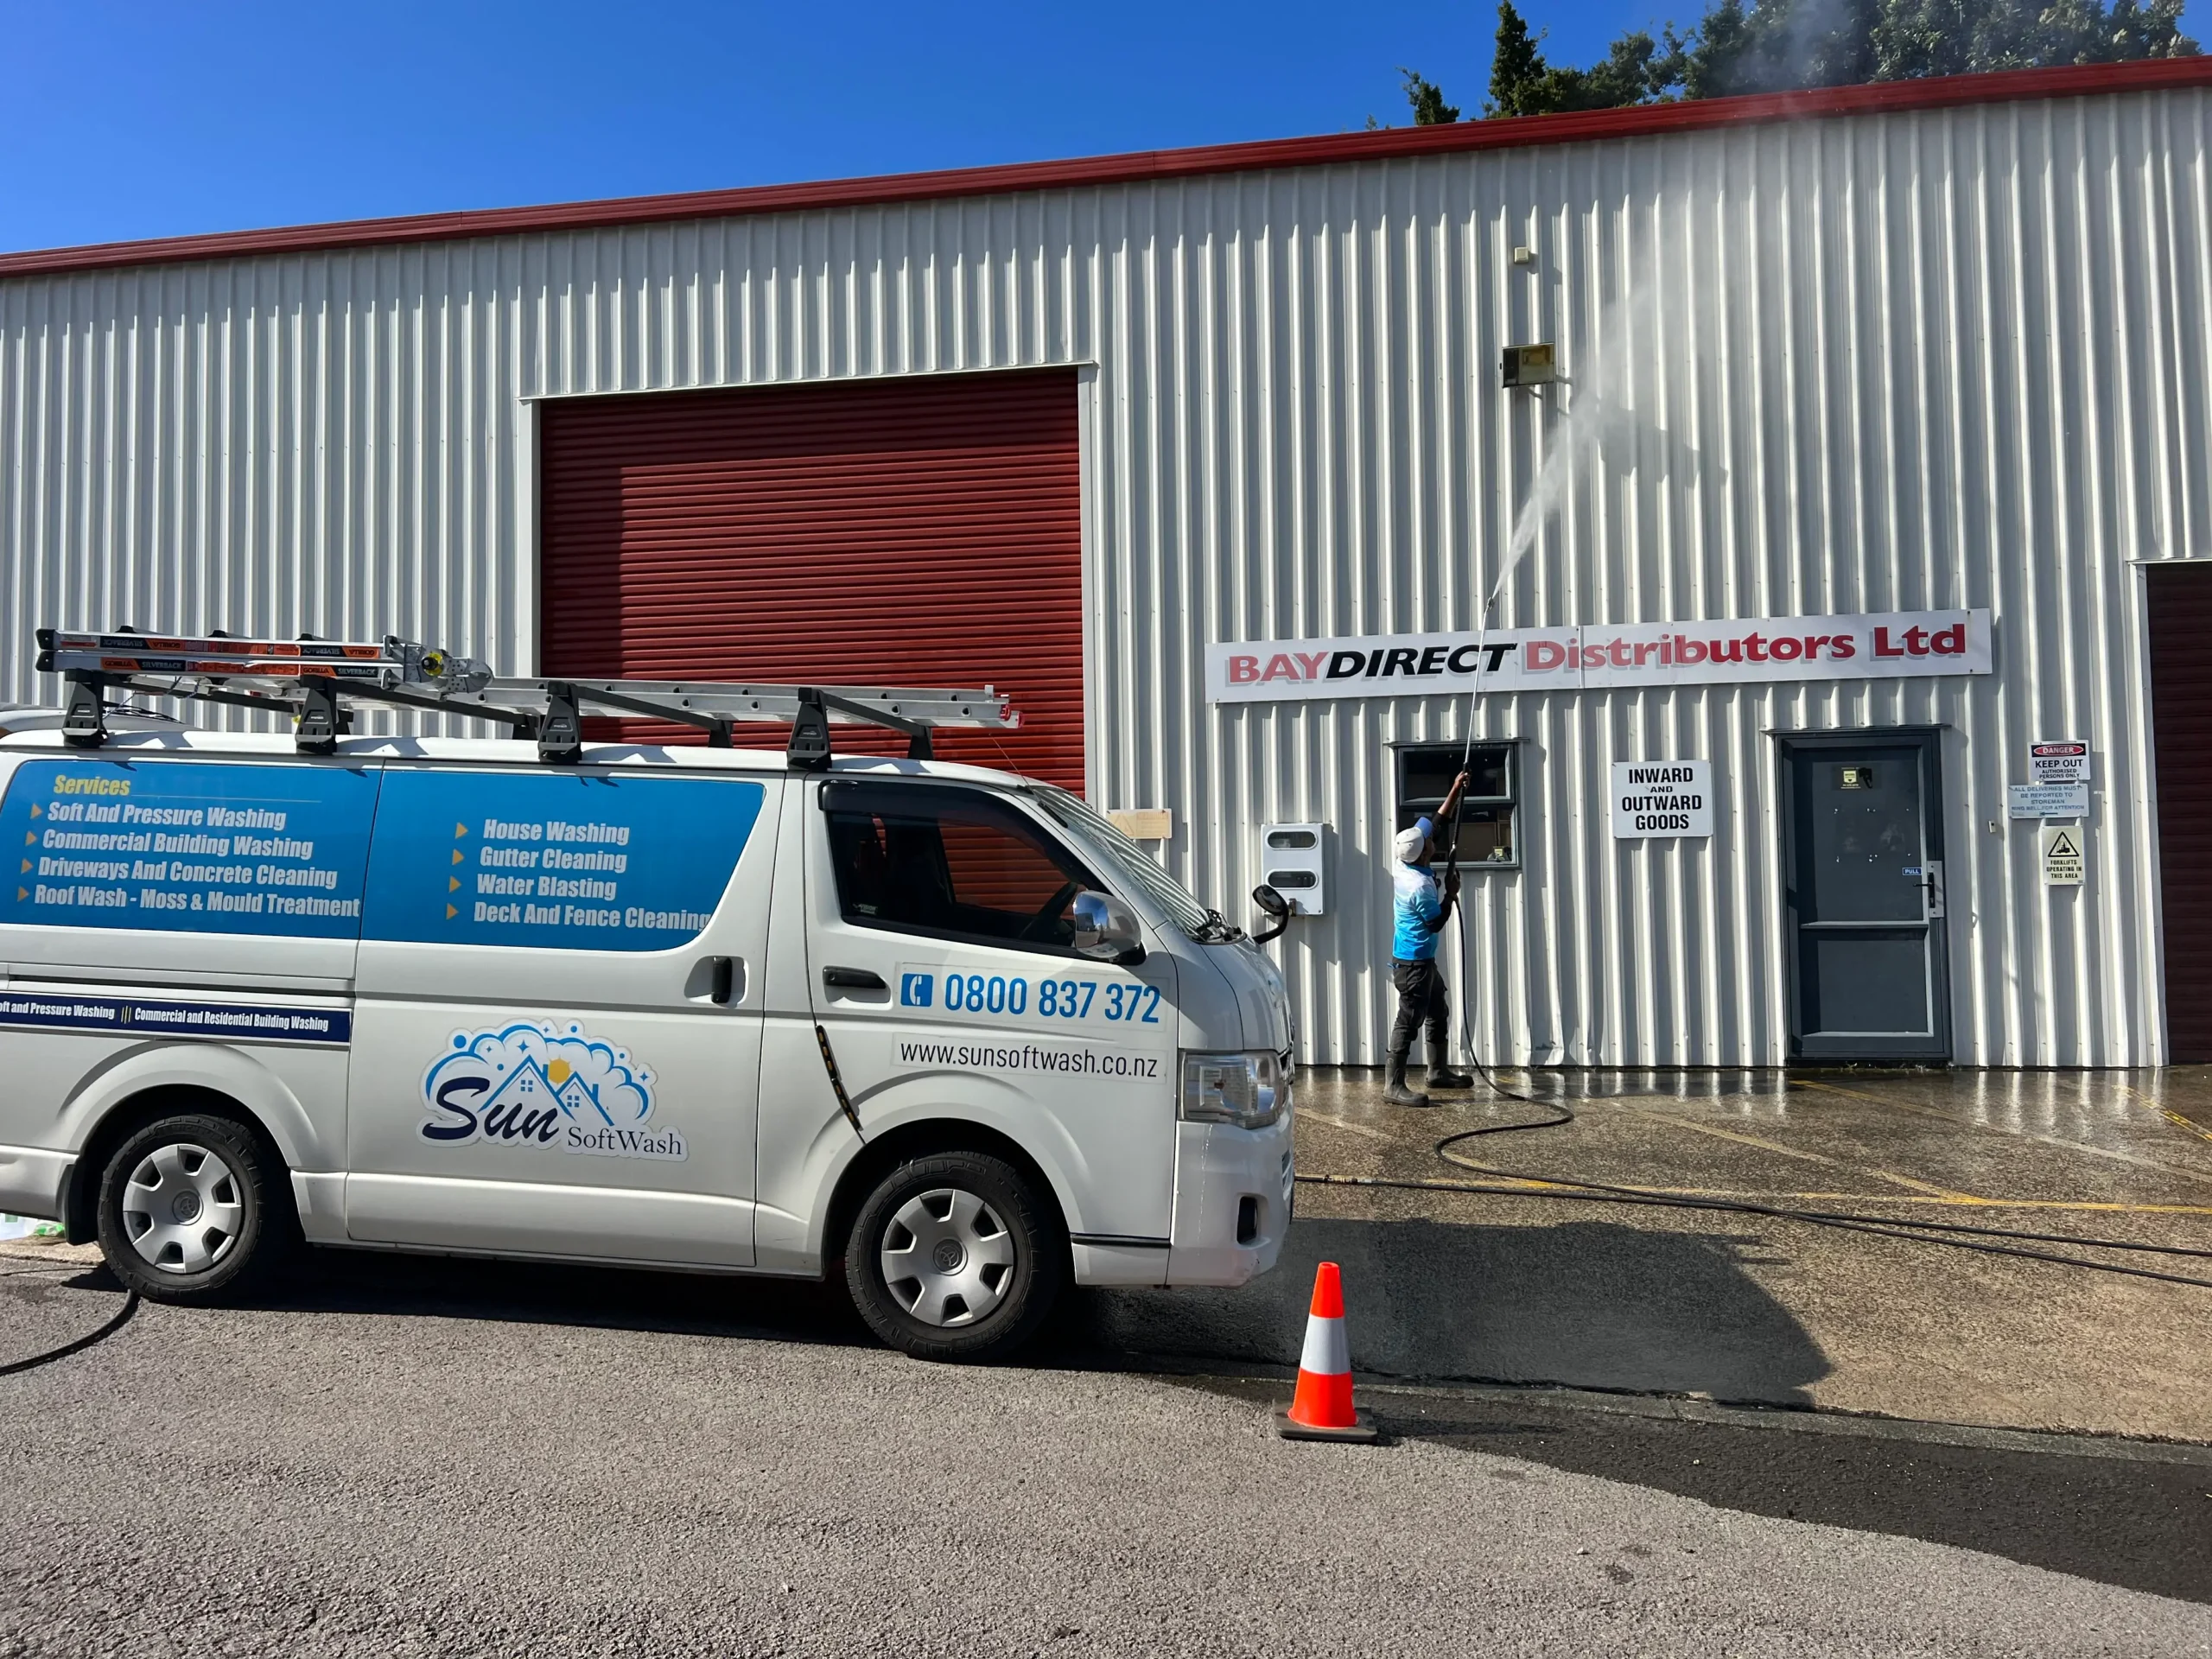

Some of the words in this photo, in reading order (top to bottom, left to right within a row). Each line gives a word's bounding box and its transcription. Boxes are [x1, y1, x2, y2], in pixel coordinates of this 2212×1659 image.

[1525, 631, 1857, 671] Distributors
[1873, 623, 1967, 658] Ltd
[1628, 767, 1694, 784] INWARD
[2035, 760, 2060, 768] KEEP
[2063, 759, 2083, 767] OUT
[53, 774, 131, 797] Services
[48, 801, 84, 822] Soft
[86, 803, 118, 823] And
[123, 805, 203, 826] Pressure
[207, 807, 286, 830] Washing
[1621, 795, 1702, 812] OUTWARD
[483, 818, 543, 842] House
[546, 821, 630, 846] Washing
[1635, 813, 1690, 830] GOODS
[42, 829, 150, 852] Commercial
[153, 832, 230, 857] Building
[233, 836, 314, 860] Washing
[38, 856, 130, 880] Driveways
[131, 860, 166, 880] And
[169, 862, 253, 885] Concrete
[256, 865, 338, 890] Cleaning
[480, 846, 540, 869] Gutter
[542, 848, 628, 874] Cleaning
[35, 884, 75, 905] Roof
[78, 887, 126, 907] Wash
[140, 888, 188, 910] Moss
[190, 893, 203, 911] &
[207, 891, 262, 913] Mould
[266, 893, 360, 917] Treatment
[477, 873, 534, 896] Water
[537, 875, 617, 901] Blasting
[474, 901, 520, 923] Deck
[524, 903, 560, 925] And
[564, 905, 620, 928] Fence
[625, 907, 712, 932] Cleaning
[944, 973, 1027, 1015] 0800
[1039, 979, 1096, 1019] 837
[1104, 983, 1161, 1023] 372
[11, 1002, 29, 1014] and
[30, 1002, 72, 1016] Pressure
[73, 1005, 115, 1020] Washing
[135, 1007, 187, 1023] Commercial
[187, 1010, 204, 1024] and
[204, 1011, 253, 1027] Residential
[253, 1014, 289, 1030] Building
[290, 1015, 328, 1033] Washing
[900, 1040, 1158, 1078] www.sunsoftwash.co.nz
[422, 1076, 560, 1143] Sun
[568, 1126, 683, 1156] SoftWash
